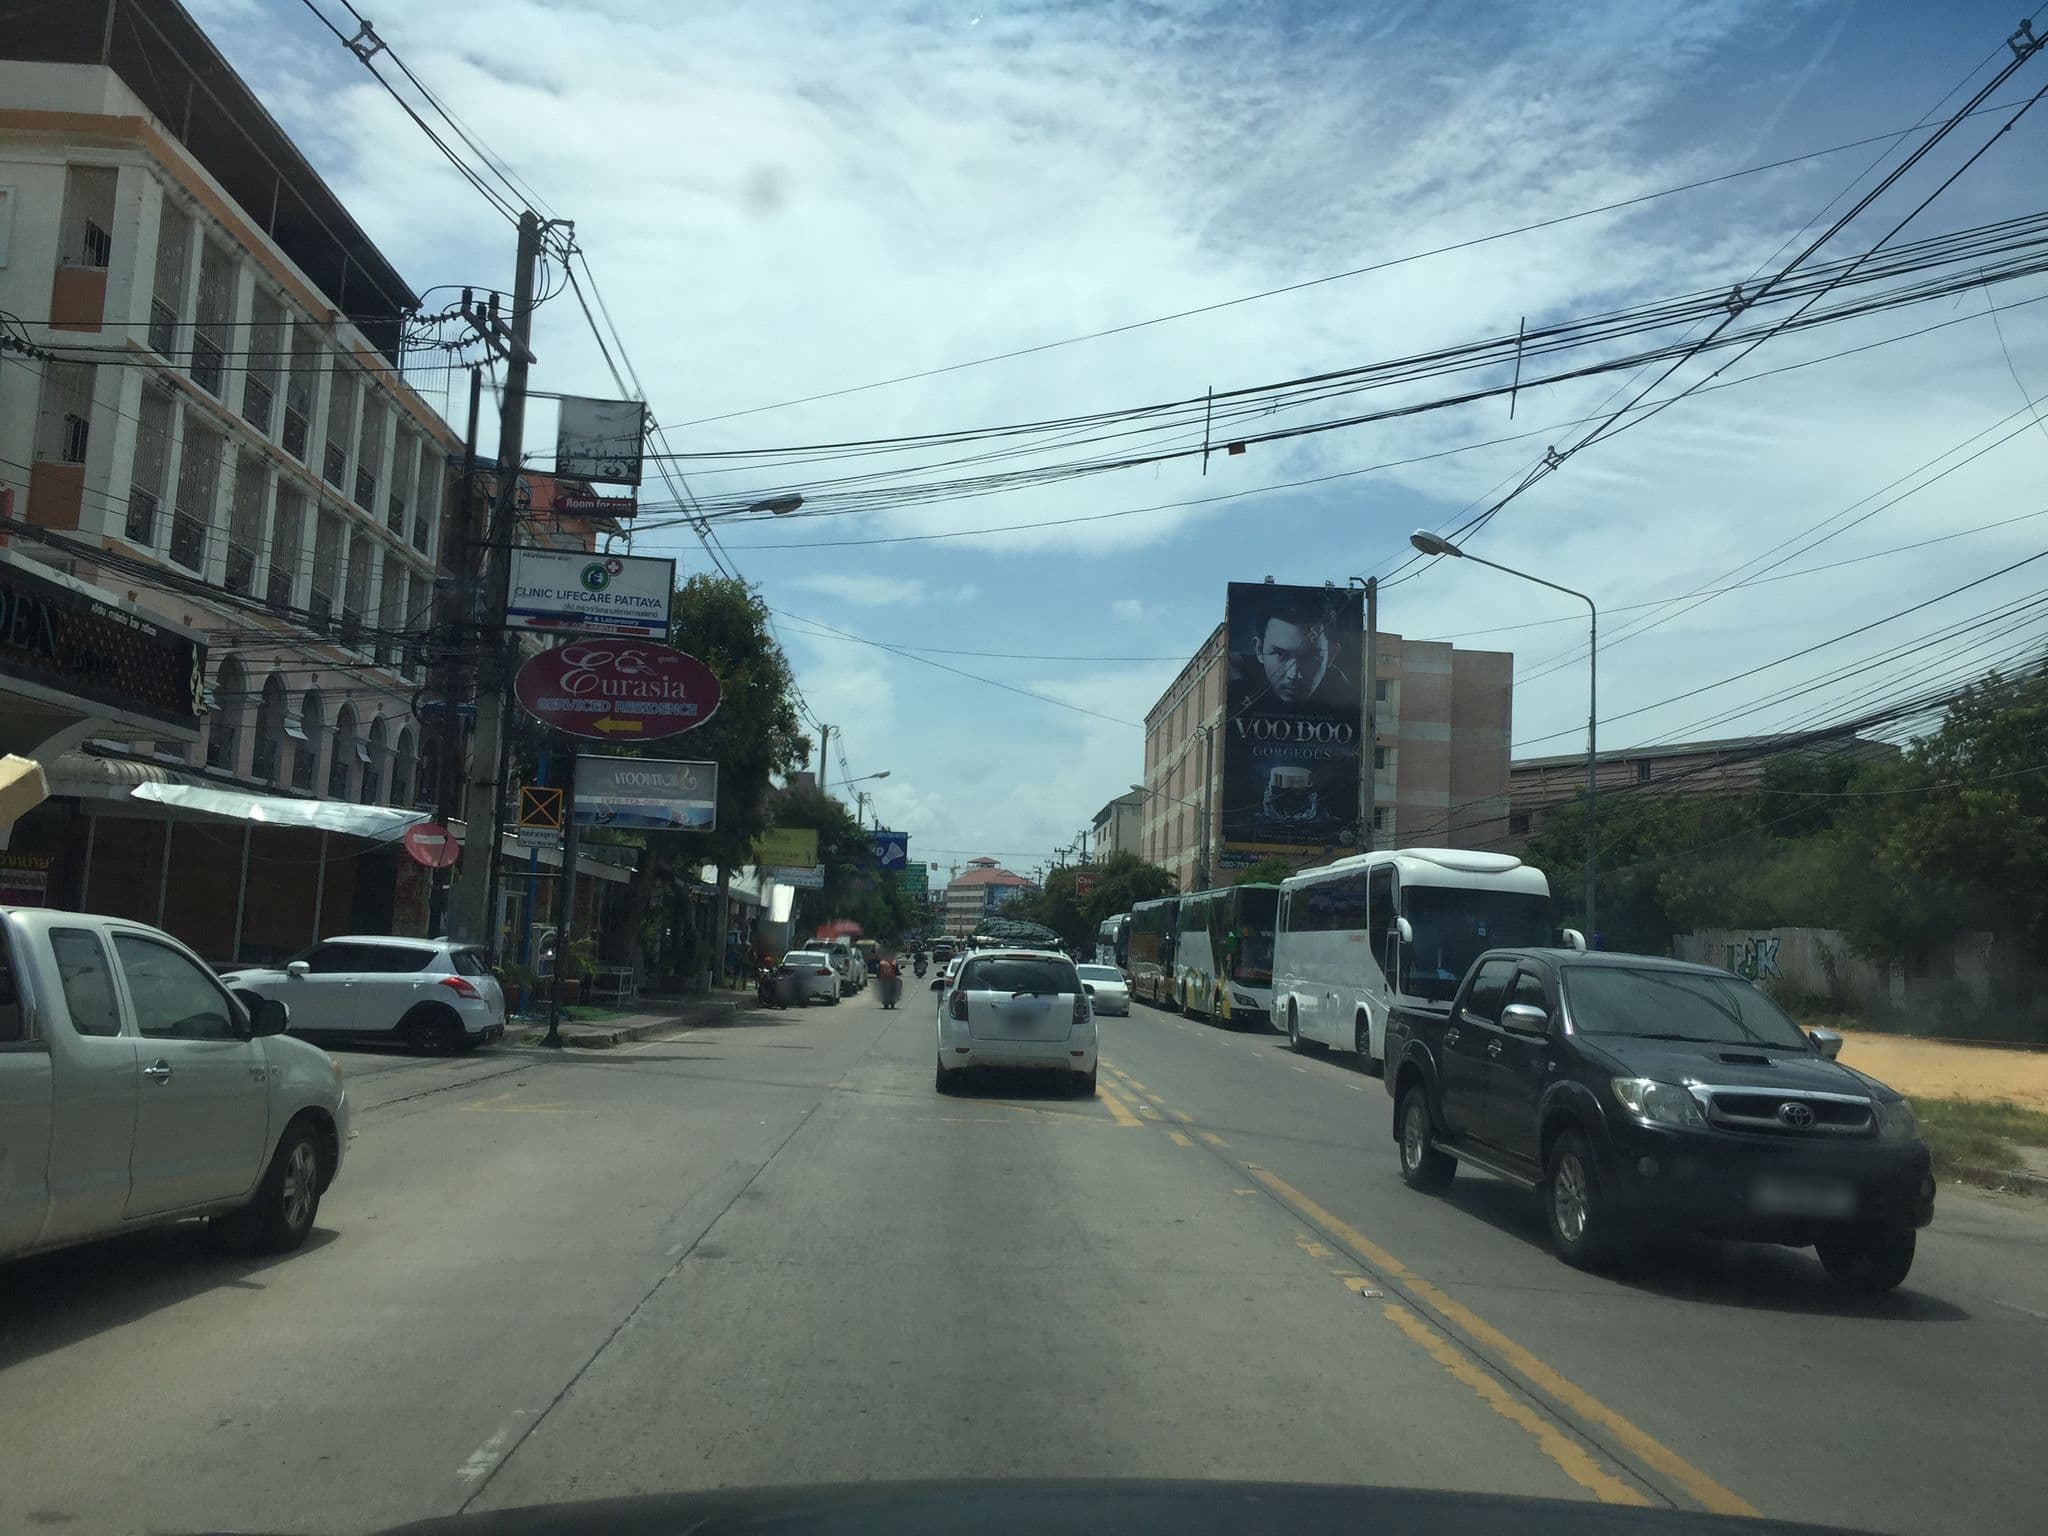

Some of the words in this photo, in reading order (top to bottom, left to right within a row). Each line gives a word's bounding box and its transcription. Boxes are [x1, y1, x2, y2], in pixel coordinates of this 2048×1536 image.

[566, 498, 594, 508] Room
[596, 500, 611, 509] for
[515, 587, 552, 599] CLINIC
[557, 591, 611, 604] LIFECARE
[614, 595, 662, 608] PATTAYA
[601, 617, 640, 627] Laboratory
[560, 647, 686, 698] Eurasia
[537, 697, 611, 713] SERVICED
[615, 701, 697, 716] RESIDENCE
